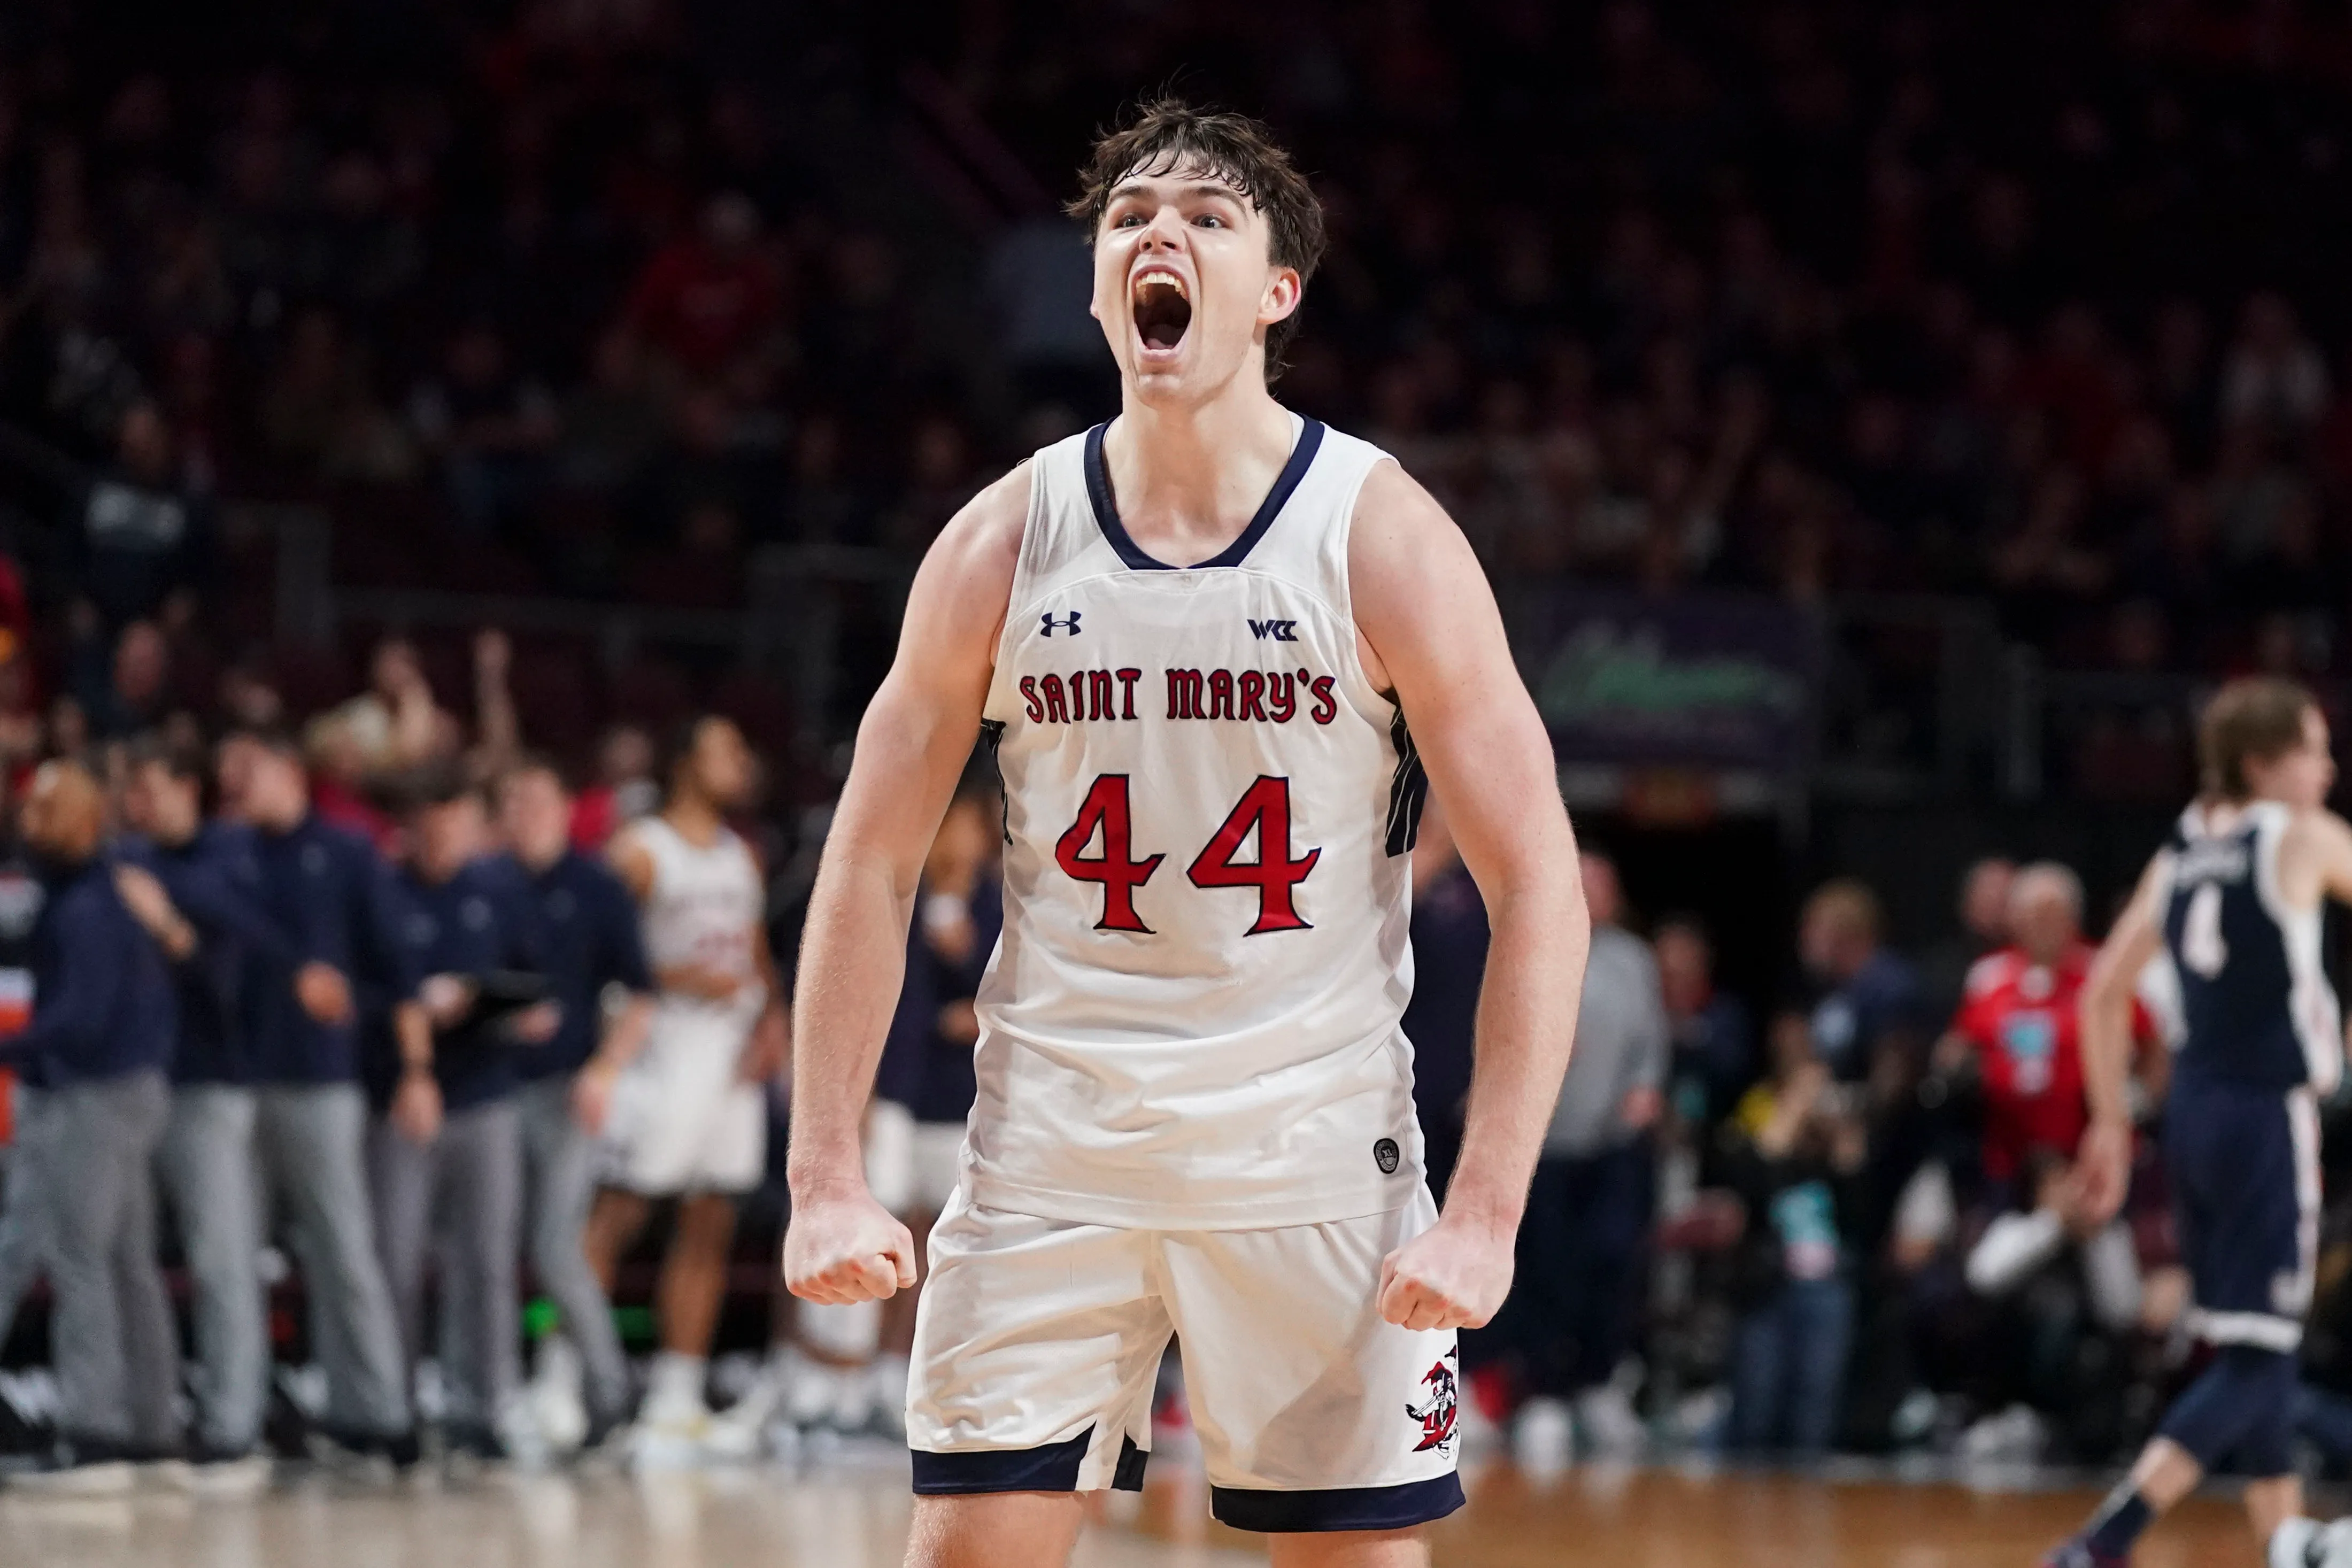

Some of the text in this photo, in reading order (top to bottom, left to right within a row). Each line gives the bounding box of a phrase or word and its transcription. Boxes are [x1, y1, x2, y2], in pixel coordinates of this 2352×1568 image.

[1246, 619, 1299, 642] WCC
[1019, 667, 1338, 725] SAINT MARY'S
[1054, 773, 1322, 937] 44
